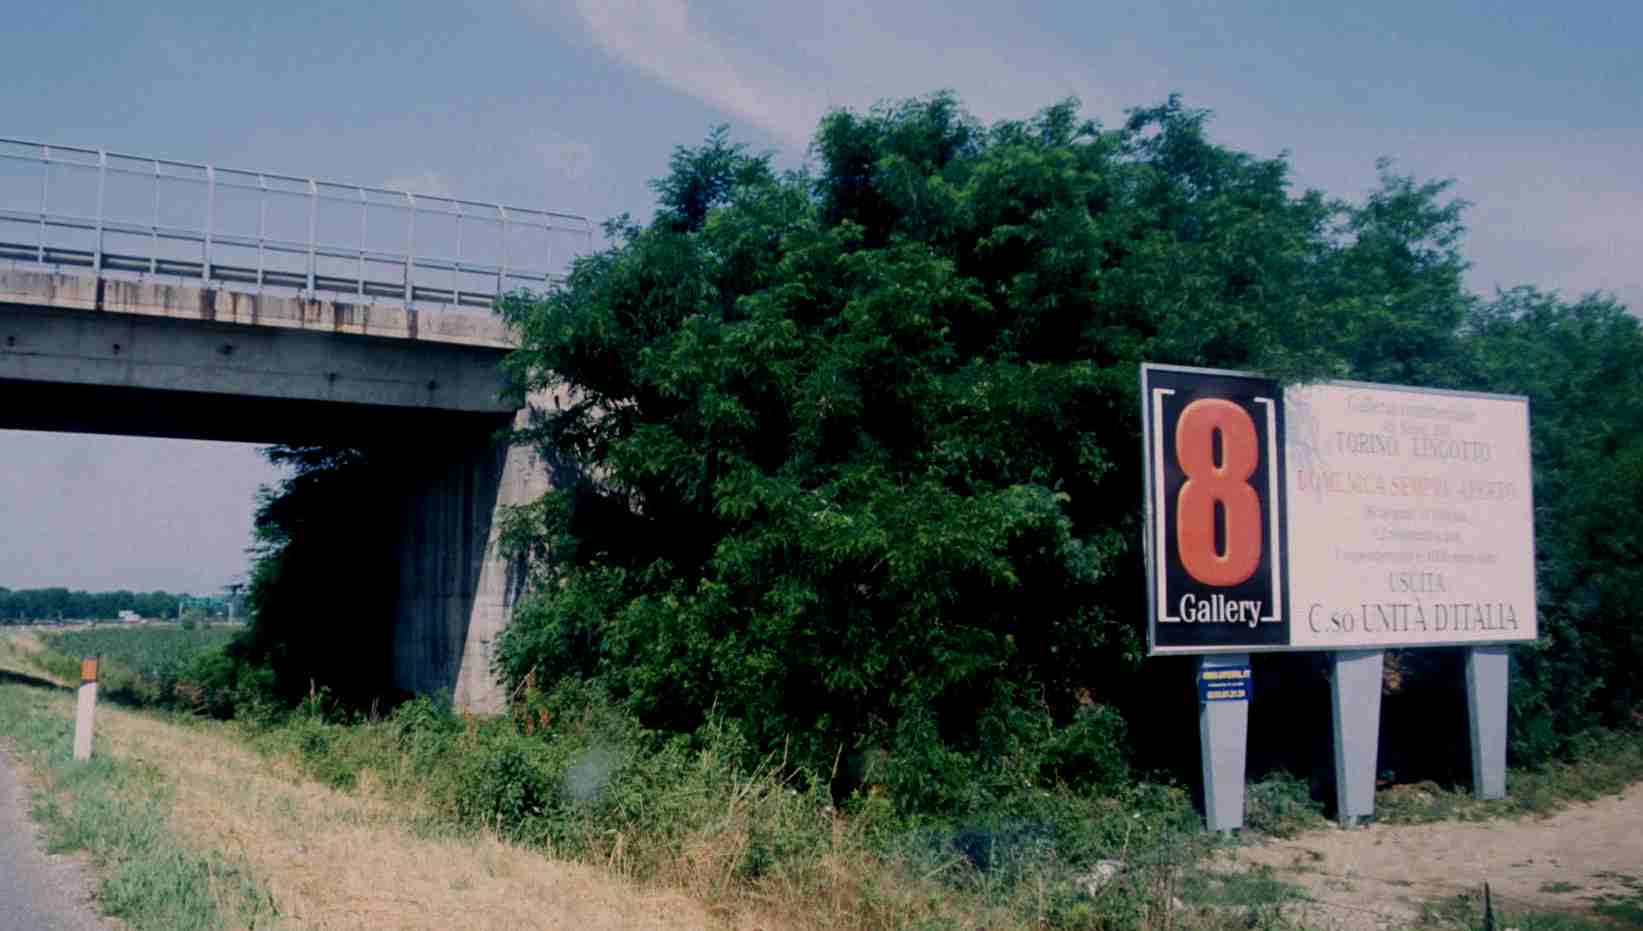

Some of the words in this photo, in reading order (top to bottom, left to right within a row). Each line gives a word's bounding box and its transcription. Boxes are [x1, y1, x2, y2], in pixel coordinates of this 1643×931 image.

[1176, 398, 1263, 587] 8
[1390, 572, 1447, 593] USCITA
[1179, 594, 1262, 628] Gallery
[1308, 603, 1354, 633] C.so
[1361, 597, 1427, 632] UNITÀ
